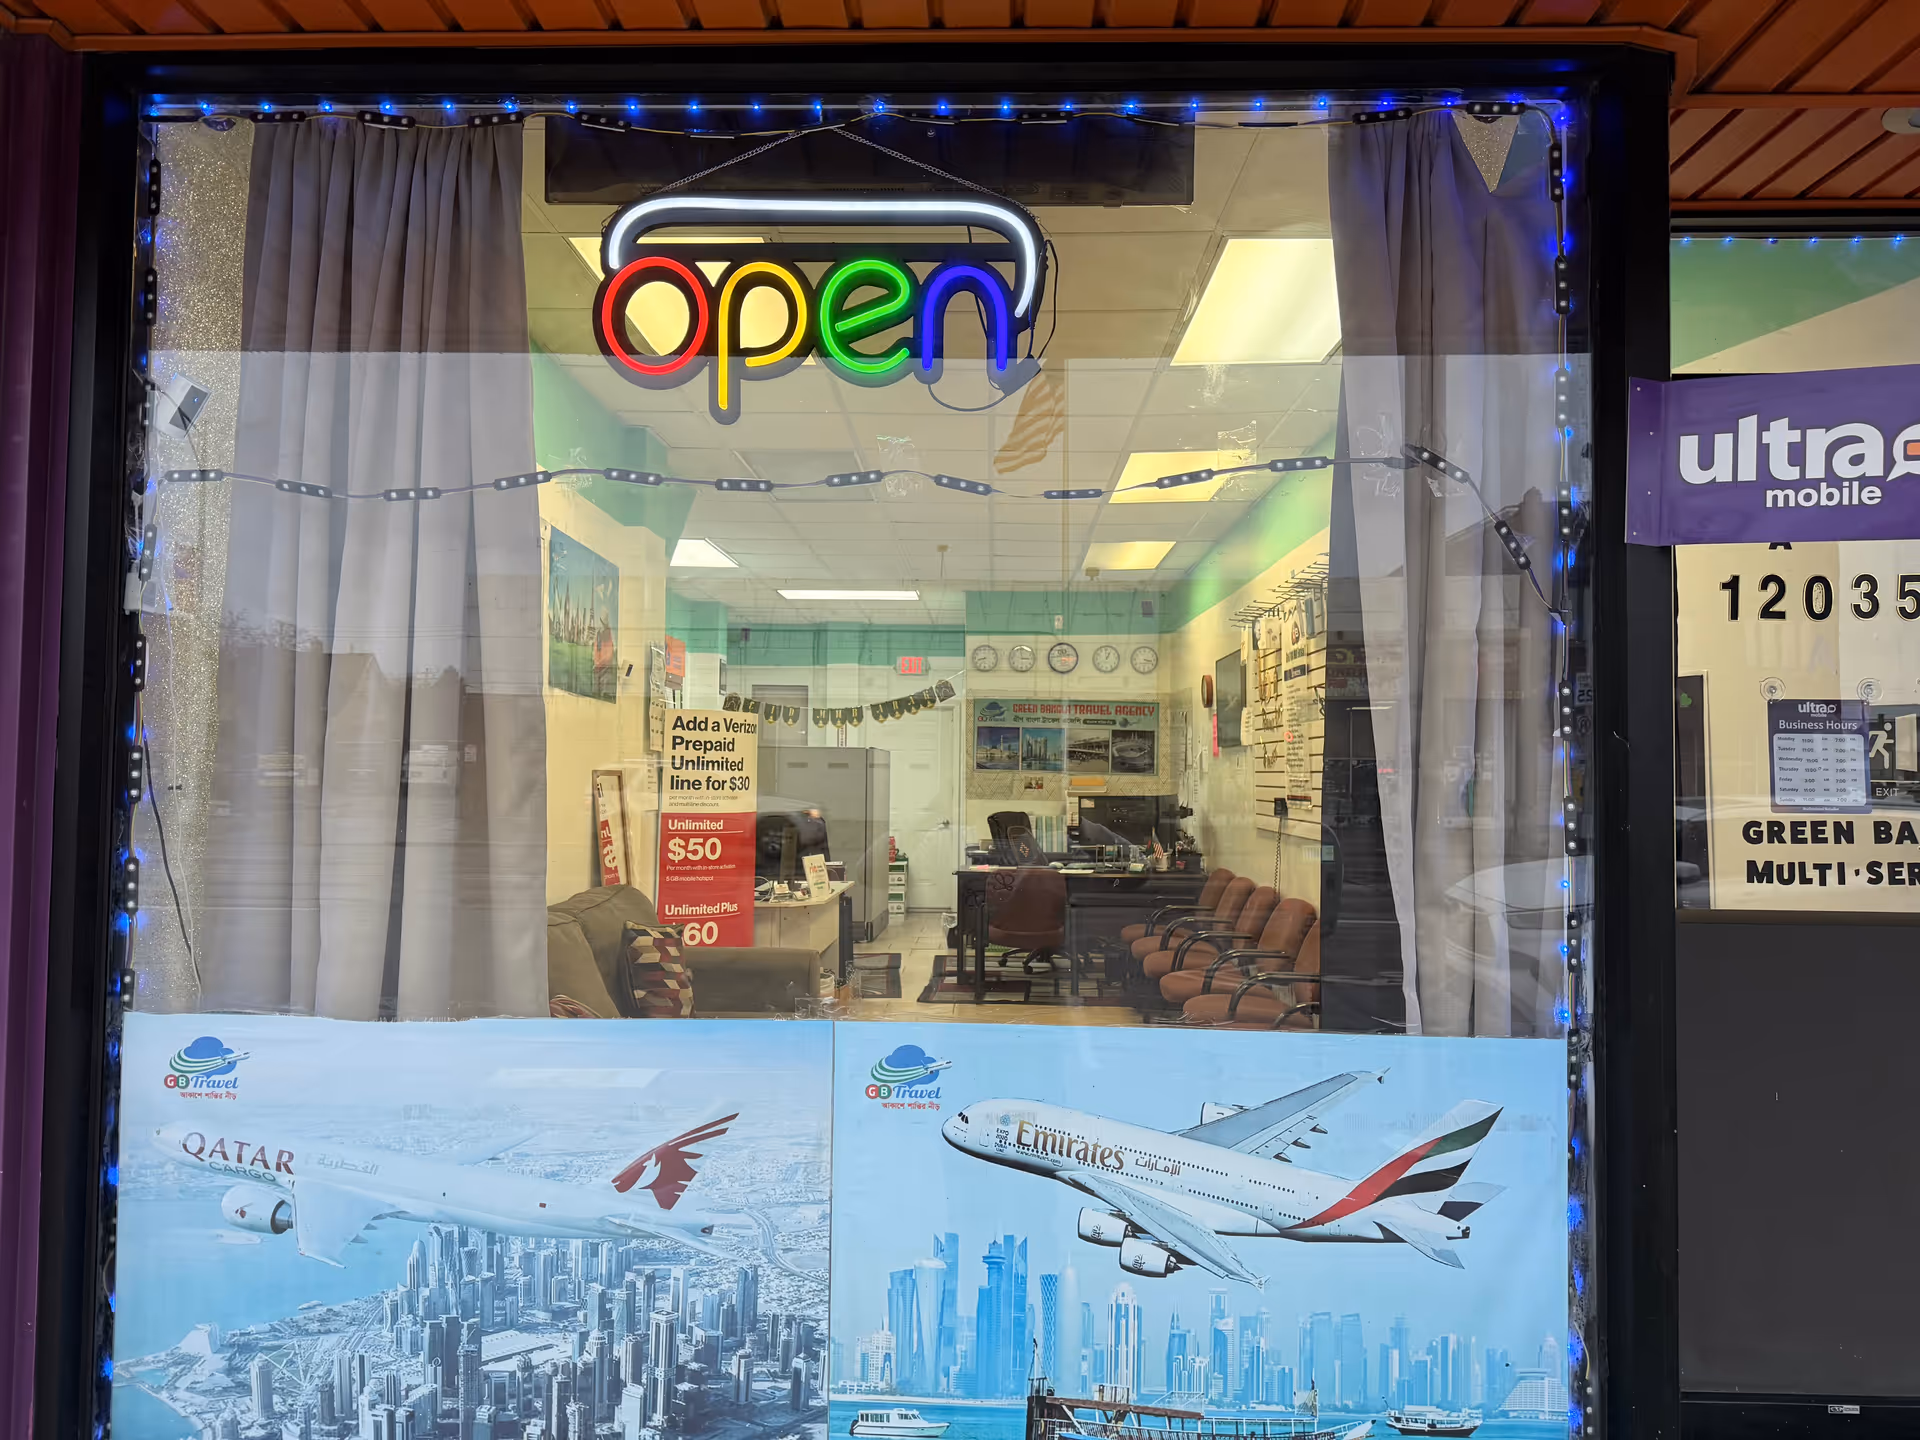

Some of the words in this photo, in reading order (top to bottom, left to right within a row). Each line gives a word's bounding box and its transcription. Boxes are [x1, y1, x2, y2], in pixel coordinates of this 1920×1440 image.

[1679, 414, 1885, 485] ultra
[1765, 481, 1882, 508] mobile
[1719, 573, 1920, 622] 12035
[901, 656, 923, 674] EXIT
[1013, 703, 1038, 713] GREEN
[1074, 704, 1112, 716] TRAVEL
[1115, 705, 1155, 716] AGENCY
[1797, 701, 1827, 713] ultra
[672, 715, 708, 731] Add
[711, 720, 720, 732] a
[1779, 719, 1824, 730] Business
[1826, 719, 1858, 730] Hours
[672, 735, 735, 754] Prepaid
[671, 755, 744, 771] Unlimited
[670, 775, 702, 790] line
[706, 775, 727, 790] for
[729, 776, 750, 792] $30
[1876, 787, 1900, 797] EXIT
[668, 819, 724, 830] Unlimited
[1742, 820, 1855, 845] GREEN
[667, 836, 722, 863] $50
[665, 903, 720, 916] Unlimited
[721, 902, 738, 912] Plus
[673, 921, 718, 946] 60
[165, 1076, 189, 1088] GB
[190, 1075, 239, 1089] Travel
[867, 1085, 890, 1098] GB
[893, 1085, 942, 1099] Travel
[182, 1131, 294, 1175] QATAR
[1016, 1120, 1125, 1171] Emirates
[209, 1161, 277, 1182] CARGO
